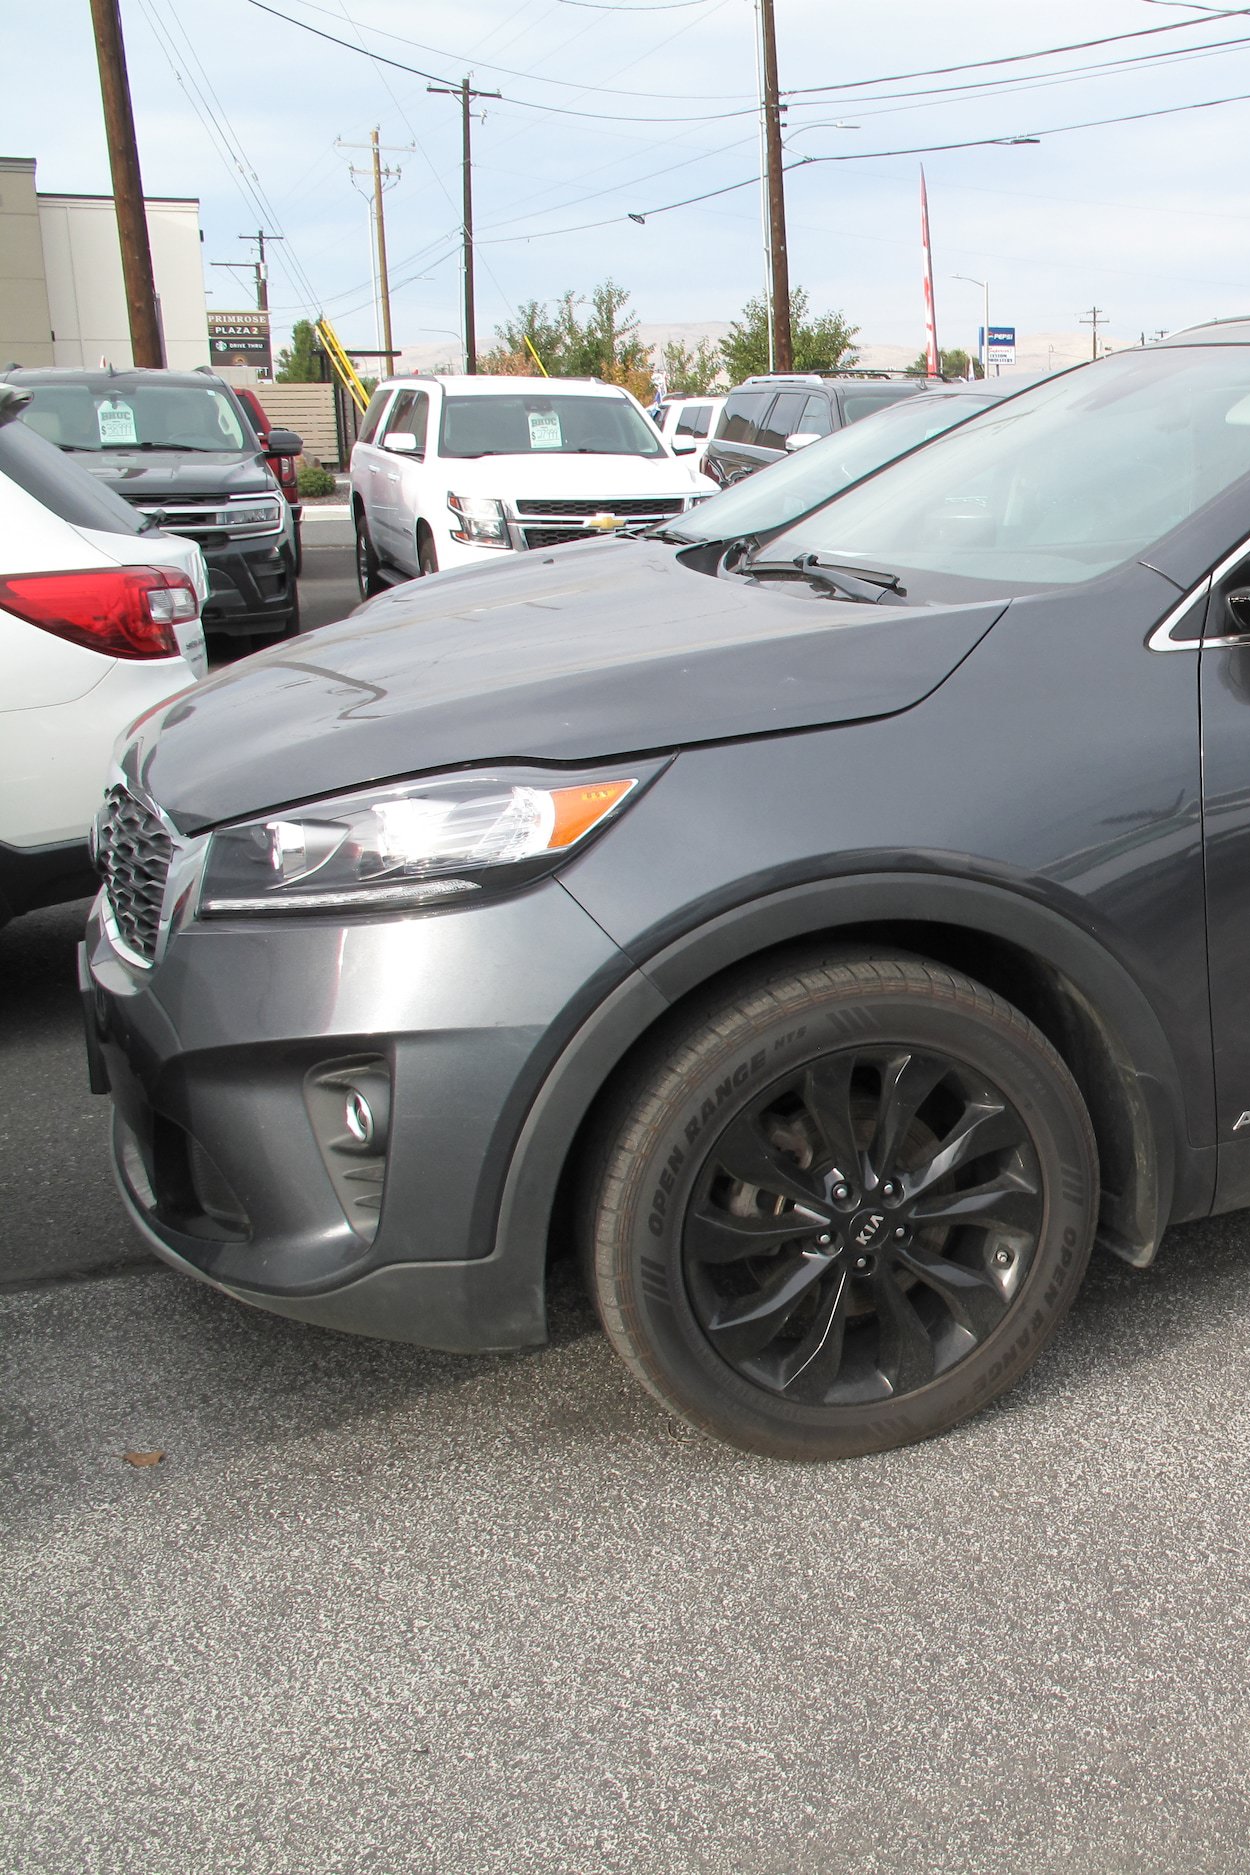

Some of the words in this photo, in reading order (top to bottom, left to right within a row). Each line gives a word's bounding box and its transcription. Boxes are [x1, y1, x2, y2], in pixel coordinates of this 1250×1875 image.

[208, 315, 266, 323] PRIMROSE
[215, 326, 250, 334] PLAZA
[252, 326, 259, 334] 2
[648, 1144, 685, 1237] OPEN
[684, 1051, 766, 1144] RANGE
[855, 1214, 884, 1245] KIA
